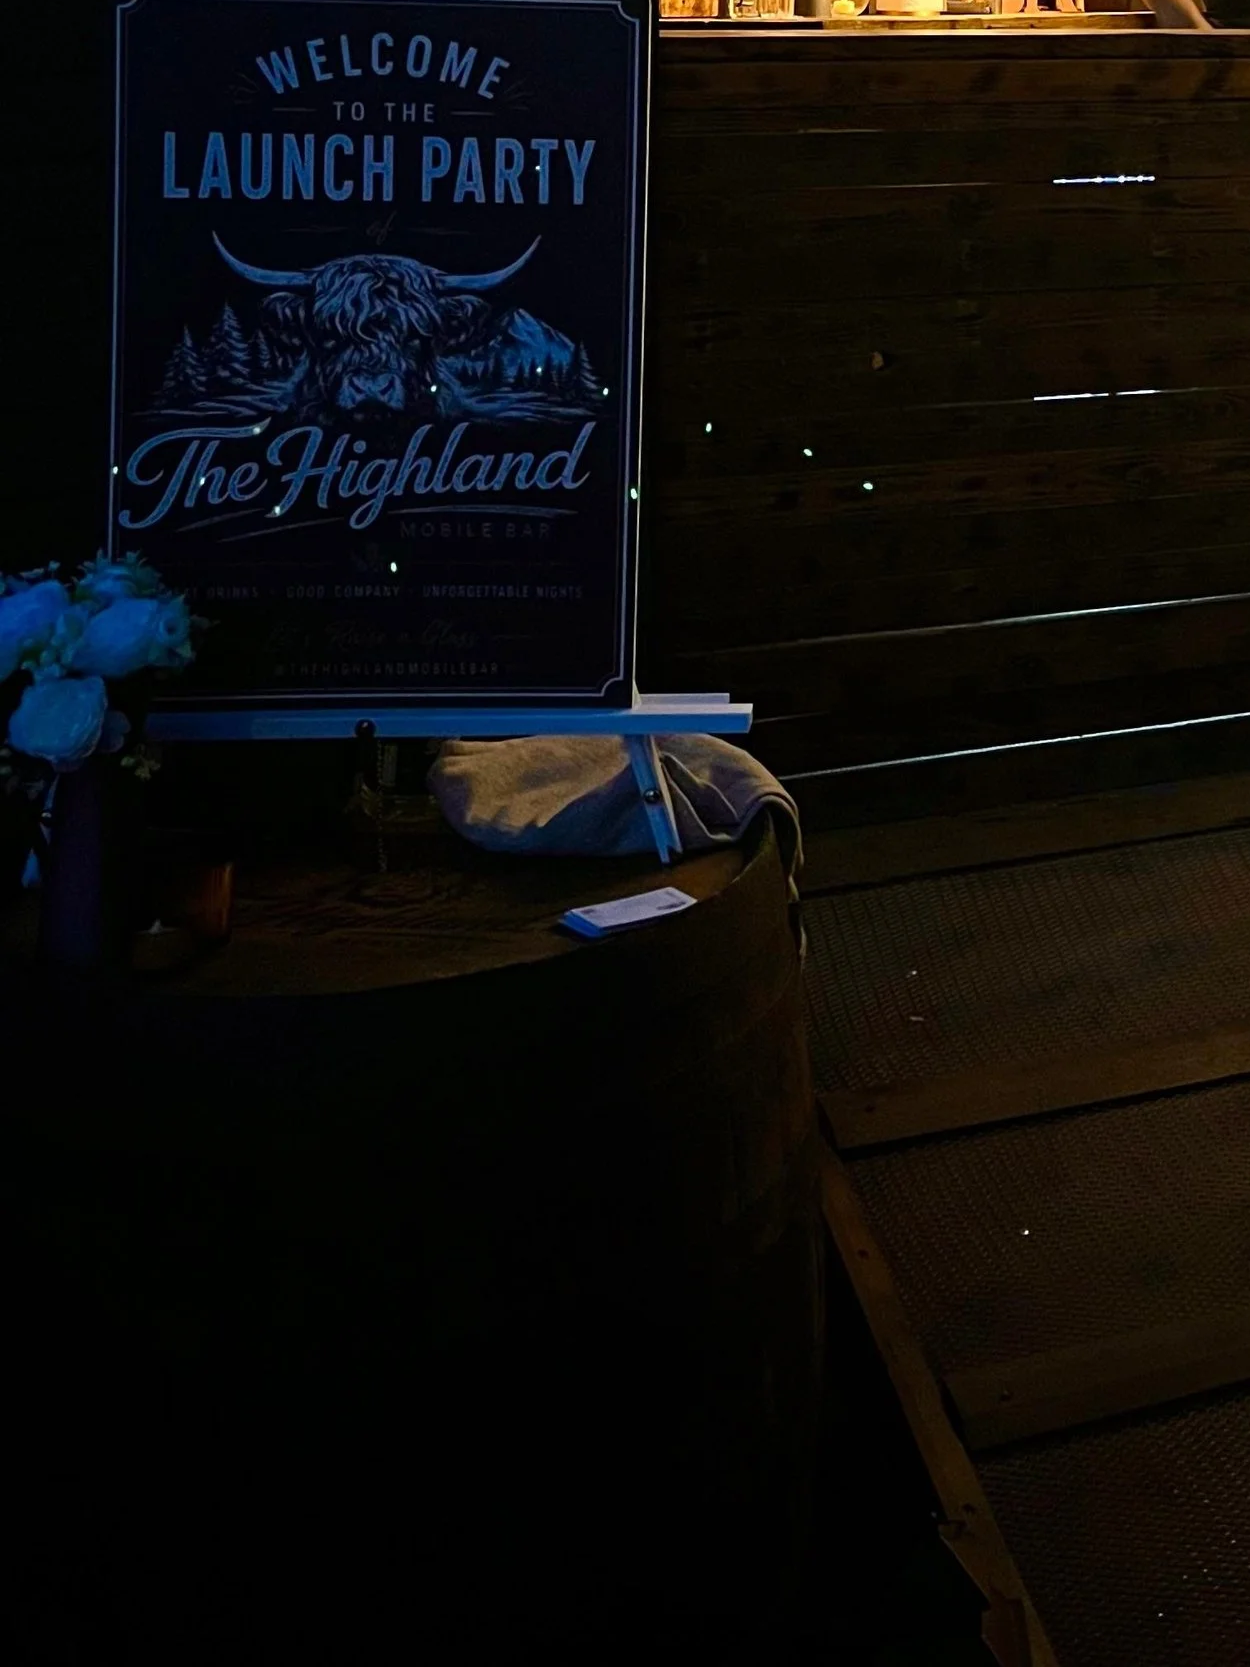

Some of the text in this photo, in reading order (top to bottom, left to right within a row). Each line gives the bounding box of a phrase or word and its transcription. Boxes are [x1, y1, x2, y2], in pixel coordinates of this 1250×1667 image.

[256, 33, 510, 99] WELCOME
[333, 102, 436, 123] TO THE
[162, 131, 596, 205] LAUNCH PARTY
[366, 210, 397, 246] of
[119, 417, 597, 530] The Highland
[400, 522, 551, 539] MOBILE BAR
